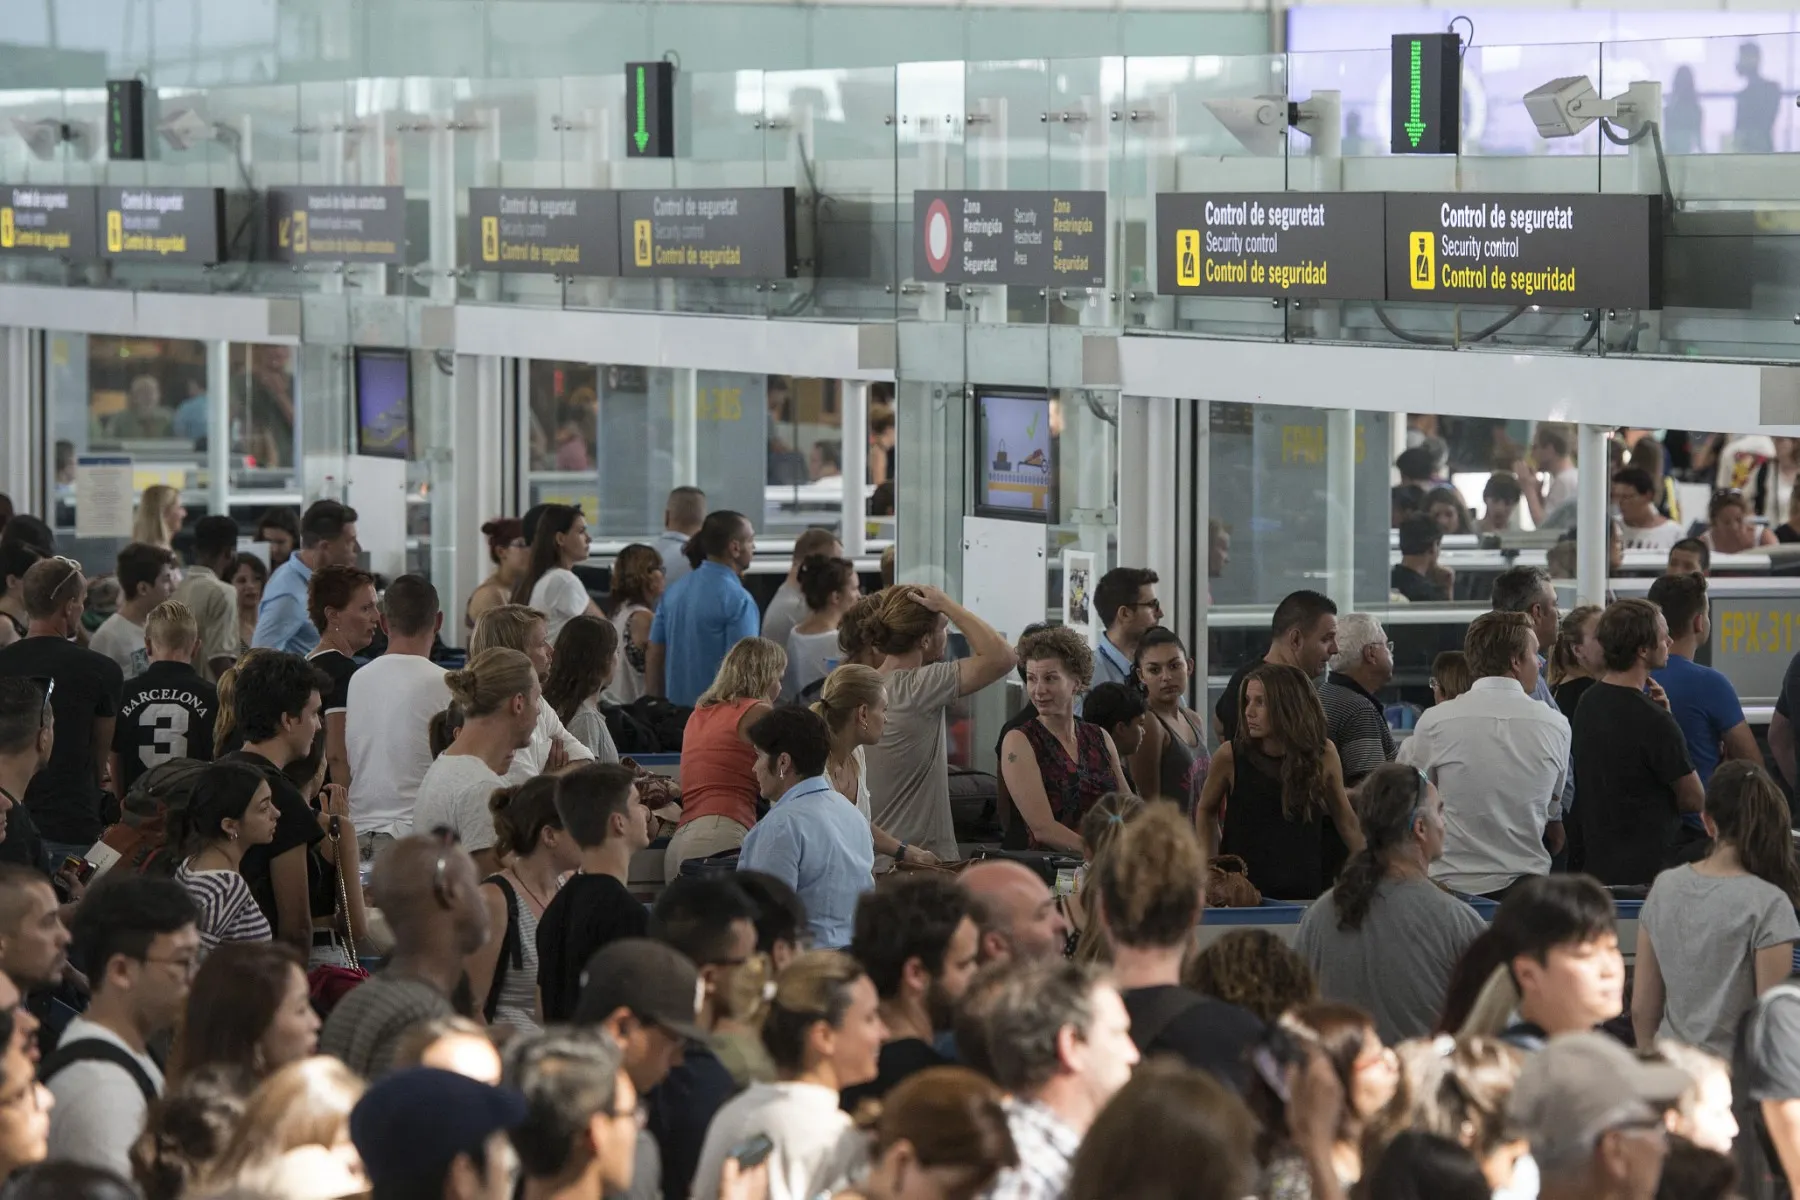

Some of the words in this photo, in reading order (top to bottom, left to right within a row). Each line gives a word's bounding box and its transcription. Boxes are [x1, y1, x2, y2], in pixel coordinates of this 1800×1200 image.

[963, 198, 981, 214] Zona
[1053, 198, 1071, 214] Zona
[1205, 200, 1247, 226] Control
[1250, 201, 1264, 226] de
[1268, 203, 1325, 231] seguretat
[1441, 202, 1486, 228] Control
[1490, 203, 1506, 229] de
[1510, 205, 1573, 234] seguretat
[963, 237, 973, 252] de
[1053, 236, 1063, 251] de
[1206, 231, 1242, 256] Security
[1245, 232, 1278, 253] control
[1442, 234, 1481, 261] Security
[1484, 236, 1519, 258] control
[1205, 258, 1247, 282] Control
[1250, 259, 1264, 283] de
[1268, 260, 1327, 289] seguridad
[1442, 264, 1487, 288] Control
[1491, 265, 1507, 290] de
[1511, 266, 1575, 295] seguridad
[121, 688, 208, 719] BARCELONA
[138, 703, 190, 769] 3
